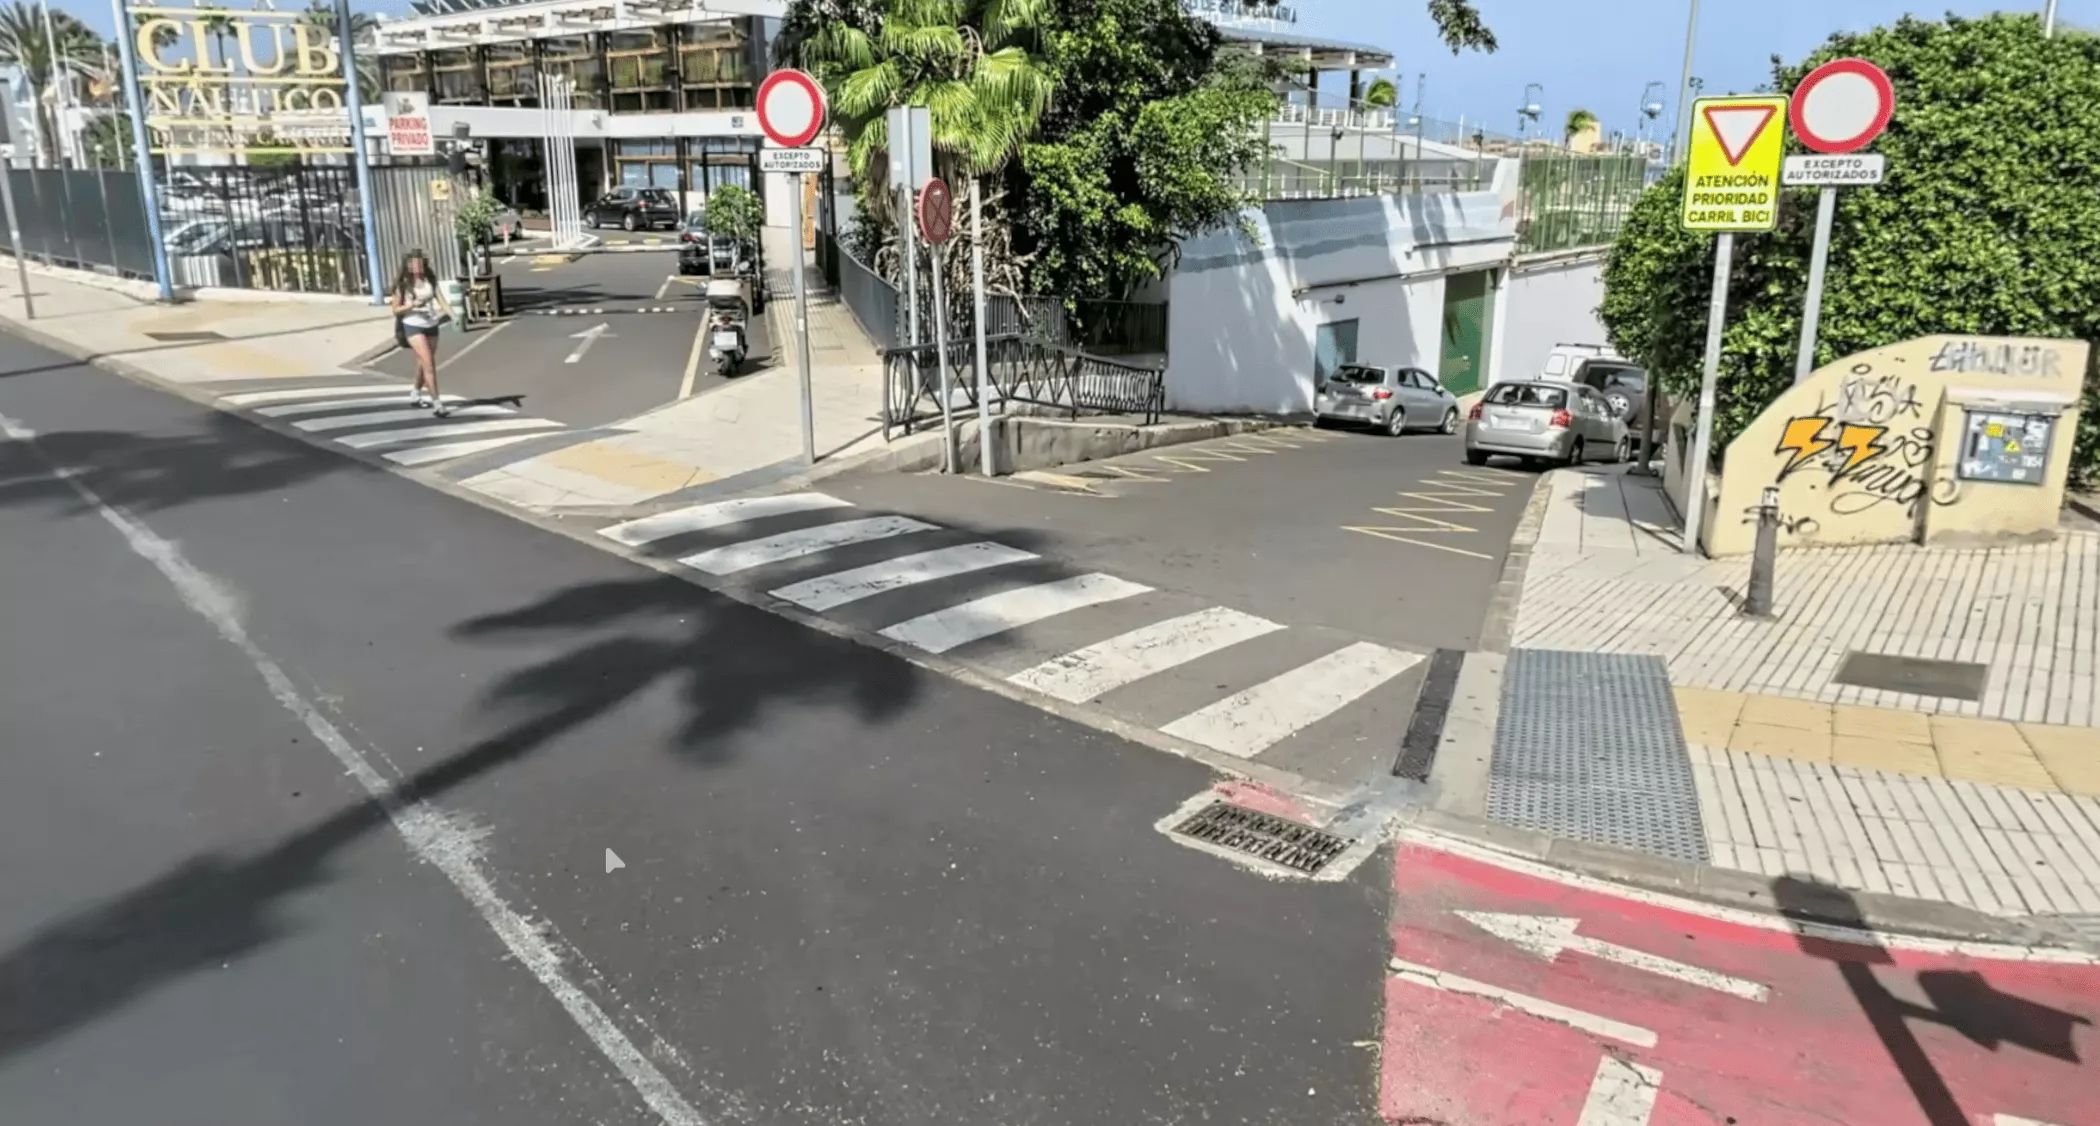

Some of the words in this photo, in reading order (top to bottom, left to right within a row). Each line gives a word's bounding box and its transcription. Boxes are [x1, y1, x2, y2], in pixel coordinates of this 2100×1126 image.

[137, 18, 339, 75] CLUB
[148, 73, 342, 120] NÁUTICO
[389, 116, 427, 131] PARKING
[391, 132, 429, 145] PRIVADO
[773, 152, 810, 160] EXCEPTO
[764, 161, 821, 169] AUTORIZADOS
[1804, 159, 1863, 169] EXCEPTO
[1695, 171, 1769, 188] ATENCIÓN
[1787, 169, 1878, 180] AUTORIZADOS
[1692, 192, 1769, 206] PRIORIDAD
[1688, 210, 1737, 223] CARRIL
[1742, 210, 1770, 223] BICI
